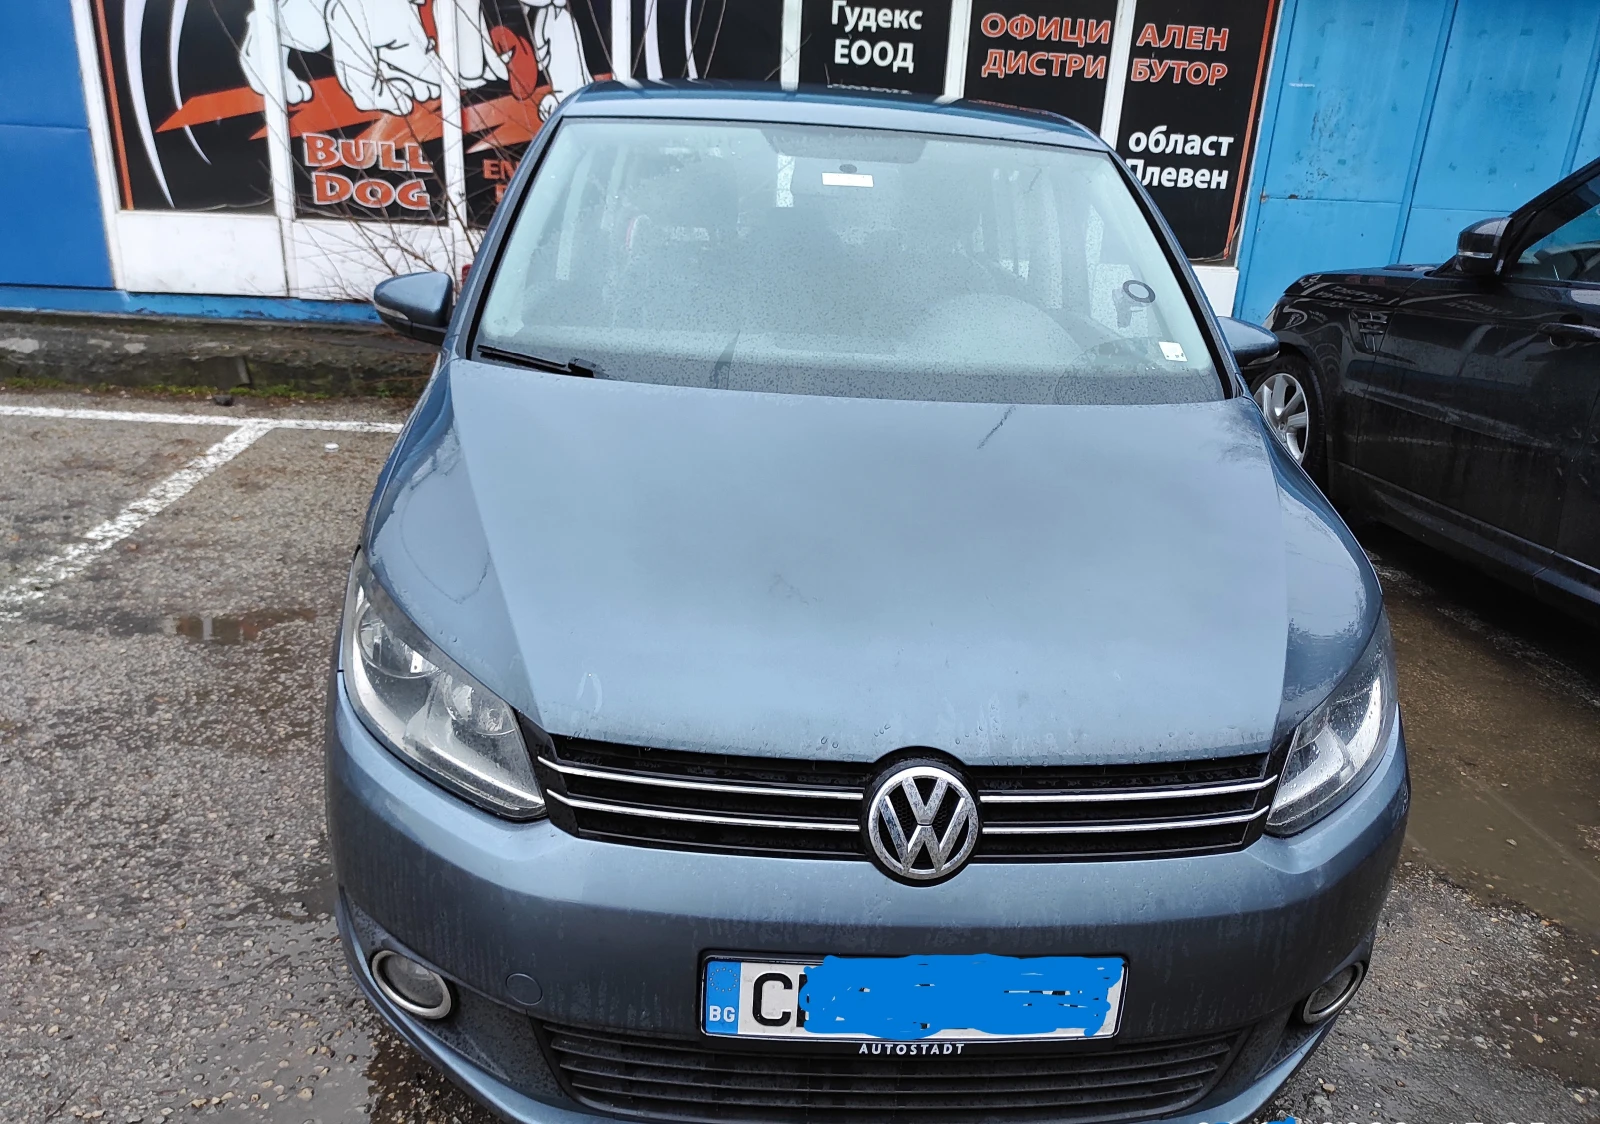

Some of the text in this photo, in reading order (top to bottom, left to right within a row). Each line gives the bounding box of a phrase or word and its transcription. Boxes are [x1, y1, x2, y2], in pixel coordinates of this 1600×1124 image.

[831, 0, 924, 33] Гудекс
[981, 13, 1229, 51] ОФИЦИ АЛЕН
[834, 38, 914, 74] ЕООД
[981, 49, 1228, 85] ДИСТРИ БУТОР
[302, 132, 434, 173] BULL
[1128, 125, 1234, 157] област
[312, 171, 431, 211] DOG
[709, 1005, 736, 1023] BG
[858, 1043, 965, 1056] AUTOSTADT
